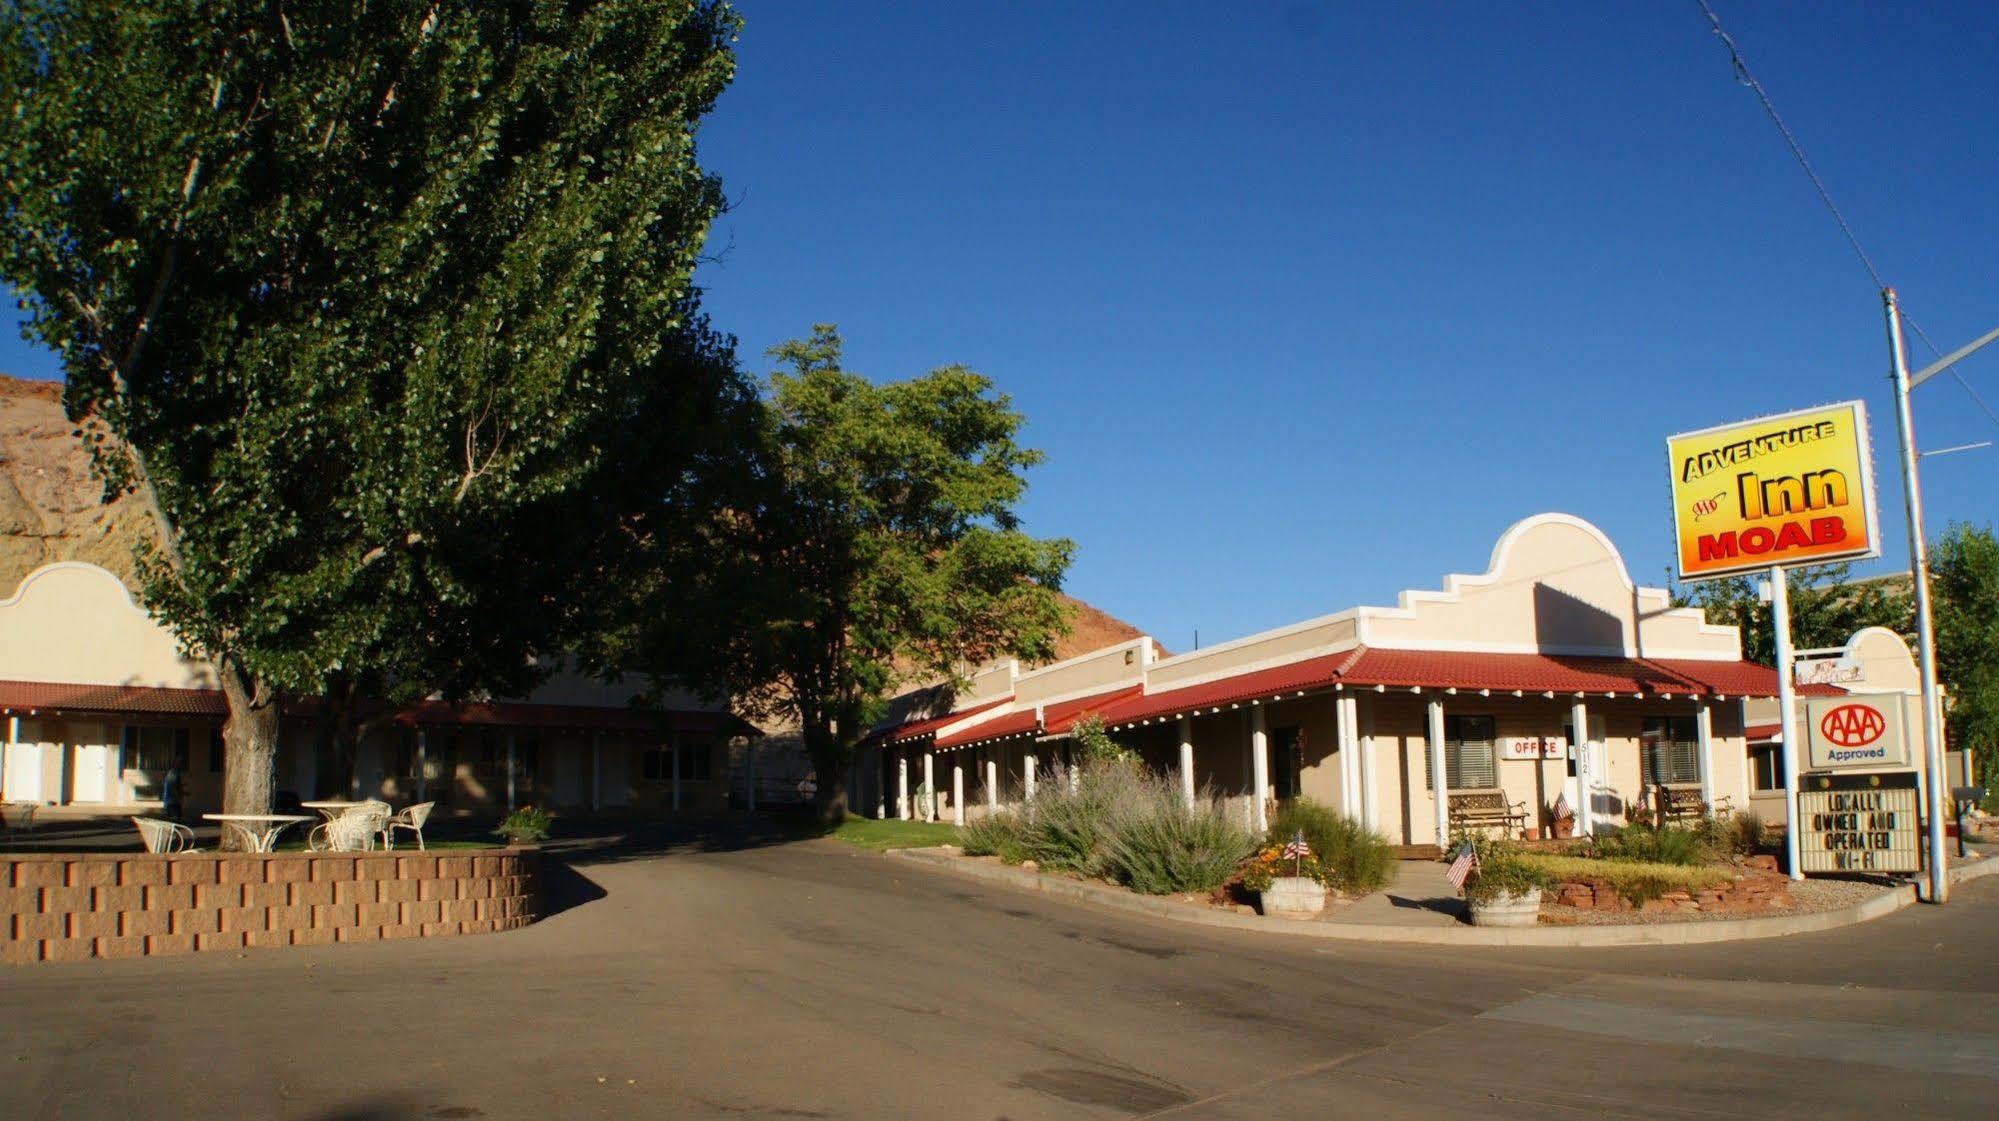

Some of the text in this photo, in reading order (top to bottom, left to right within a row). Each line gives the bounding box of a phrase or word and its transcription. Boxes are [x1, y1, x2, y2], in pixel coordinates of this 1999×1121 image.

[1682, 421, 1836, 483] ADVENTURE
[1737, 469, 1849, 520] Inn
[1698, 516, 1847, 562] MOAB
[1825, 705, 1881, 746] AAA
[1515, 742, 1557, 754] OFFICE
[1828, 747, 1885, 761] Approved
[1828, 793, 1882, 811] LOCALLY
[1814, 812, 1895, 831] OWNED AND
[1825, 832, 1890, 850] OPERATED
[1835, 851, 1875, 869] WI-FI
